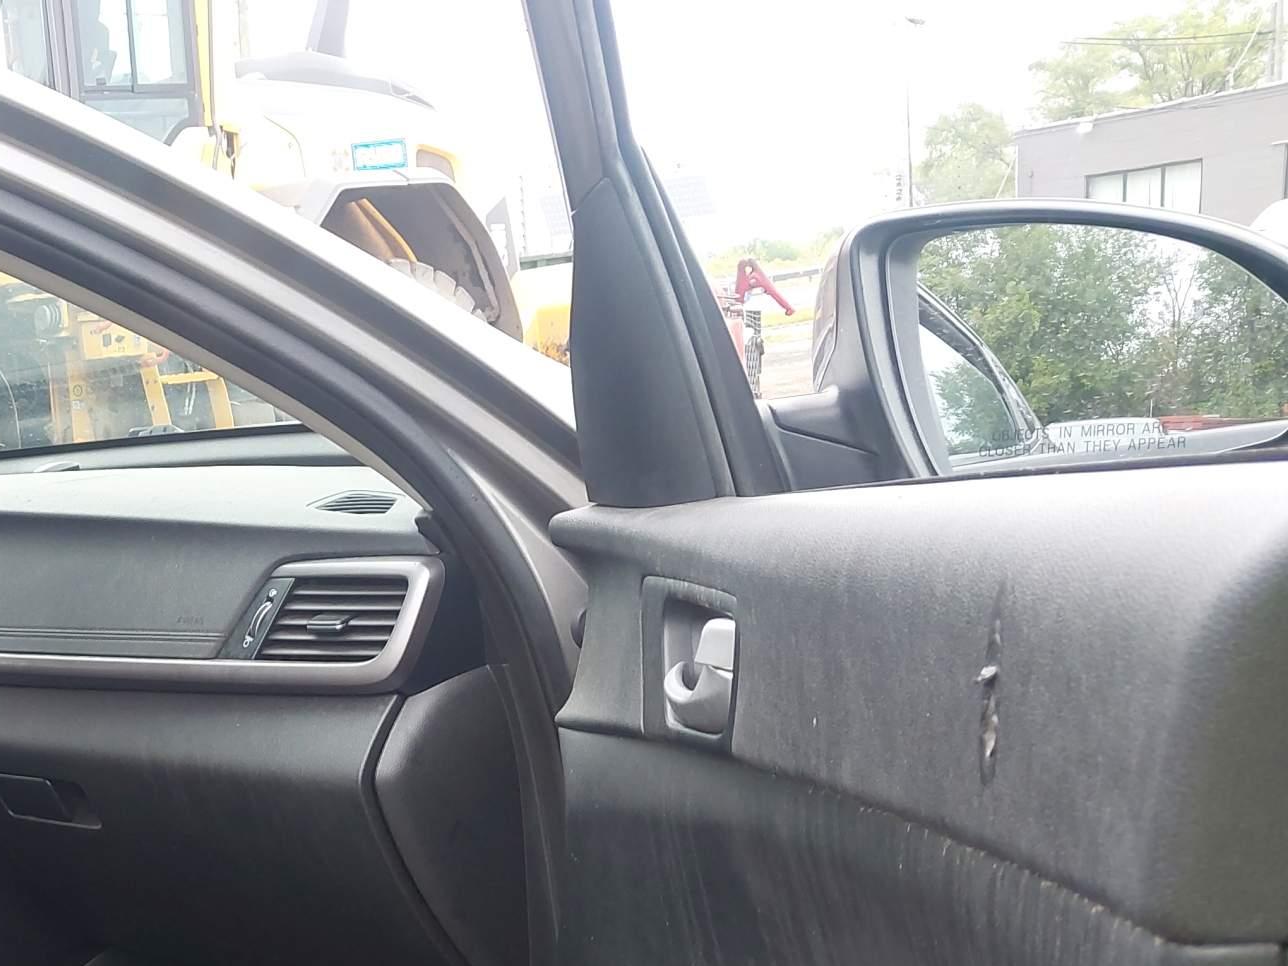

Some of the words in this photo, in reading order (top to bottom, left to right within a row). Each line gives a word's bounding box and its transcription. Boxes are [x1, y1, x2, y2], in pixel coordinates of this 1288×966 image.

[992, 427, 1050, 442] OBJECTS
[1059, 426, 1073, 439] IN
[1080, 423, 1135, 438] MIRROR
[1142, 421, 1169, 436] ARE
[978, 442, 1032, 457] CLOSER
[1039, 441, 1076, 455] THAN
[1084, 438, 1121, 453] THEY
[1127, 436, 1187, 451] APPEAR
